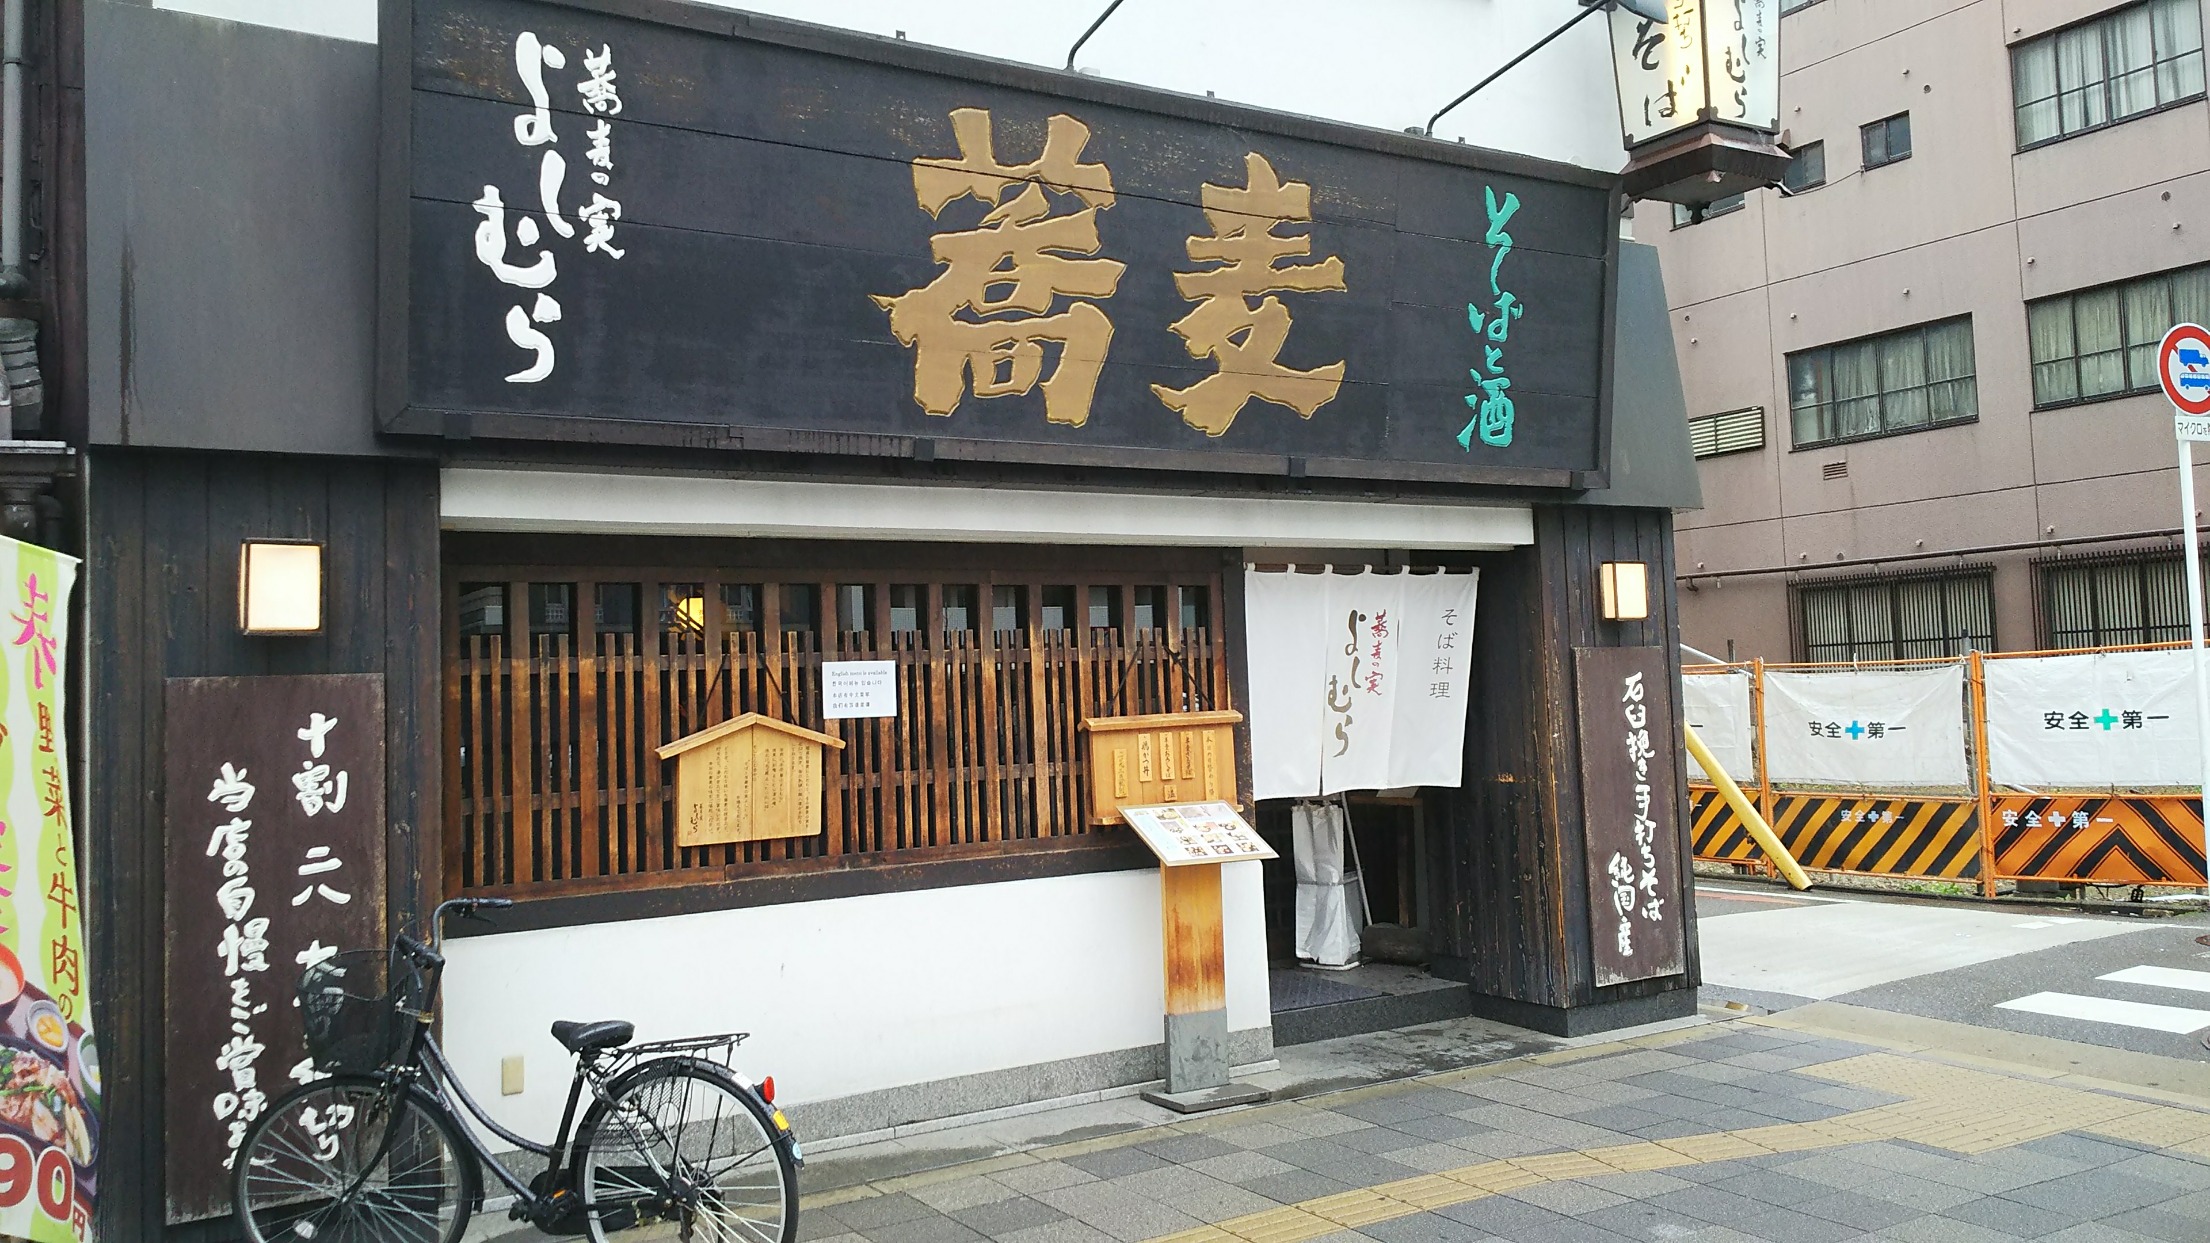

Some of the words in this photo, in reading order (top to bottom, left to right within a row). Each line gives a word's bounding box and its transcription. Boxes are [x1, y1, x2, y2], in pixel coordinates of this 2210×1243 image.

[1632, 18, 1691, 127] そば
[473, 31, 575, 383] よしむら
[577, 43, 625, 260] 蕎麦の実
[868, 107, 1347, 439] 蕎麦
[1455, 184, 1523, 453] そばと酒
[2178, 421, 2210, 436] マイクロを
[1327, 609, 1367, 758] よしむら
[1364, 608, 1390, 696] 蕎麦の実
[1429, 608, 1459, 699] そば料理
[1622, 671, 1665, 922] 石臼挽き手打ちそば
[1608, 851, 1636, 957] 純国産
